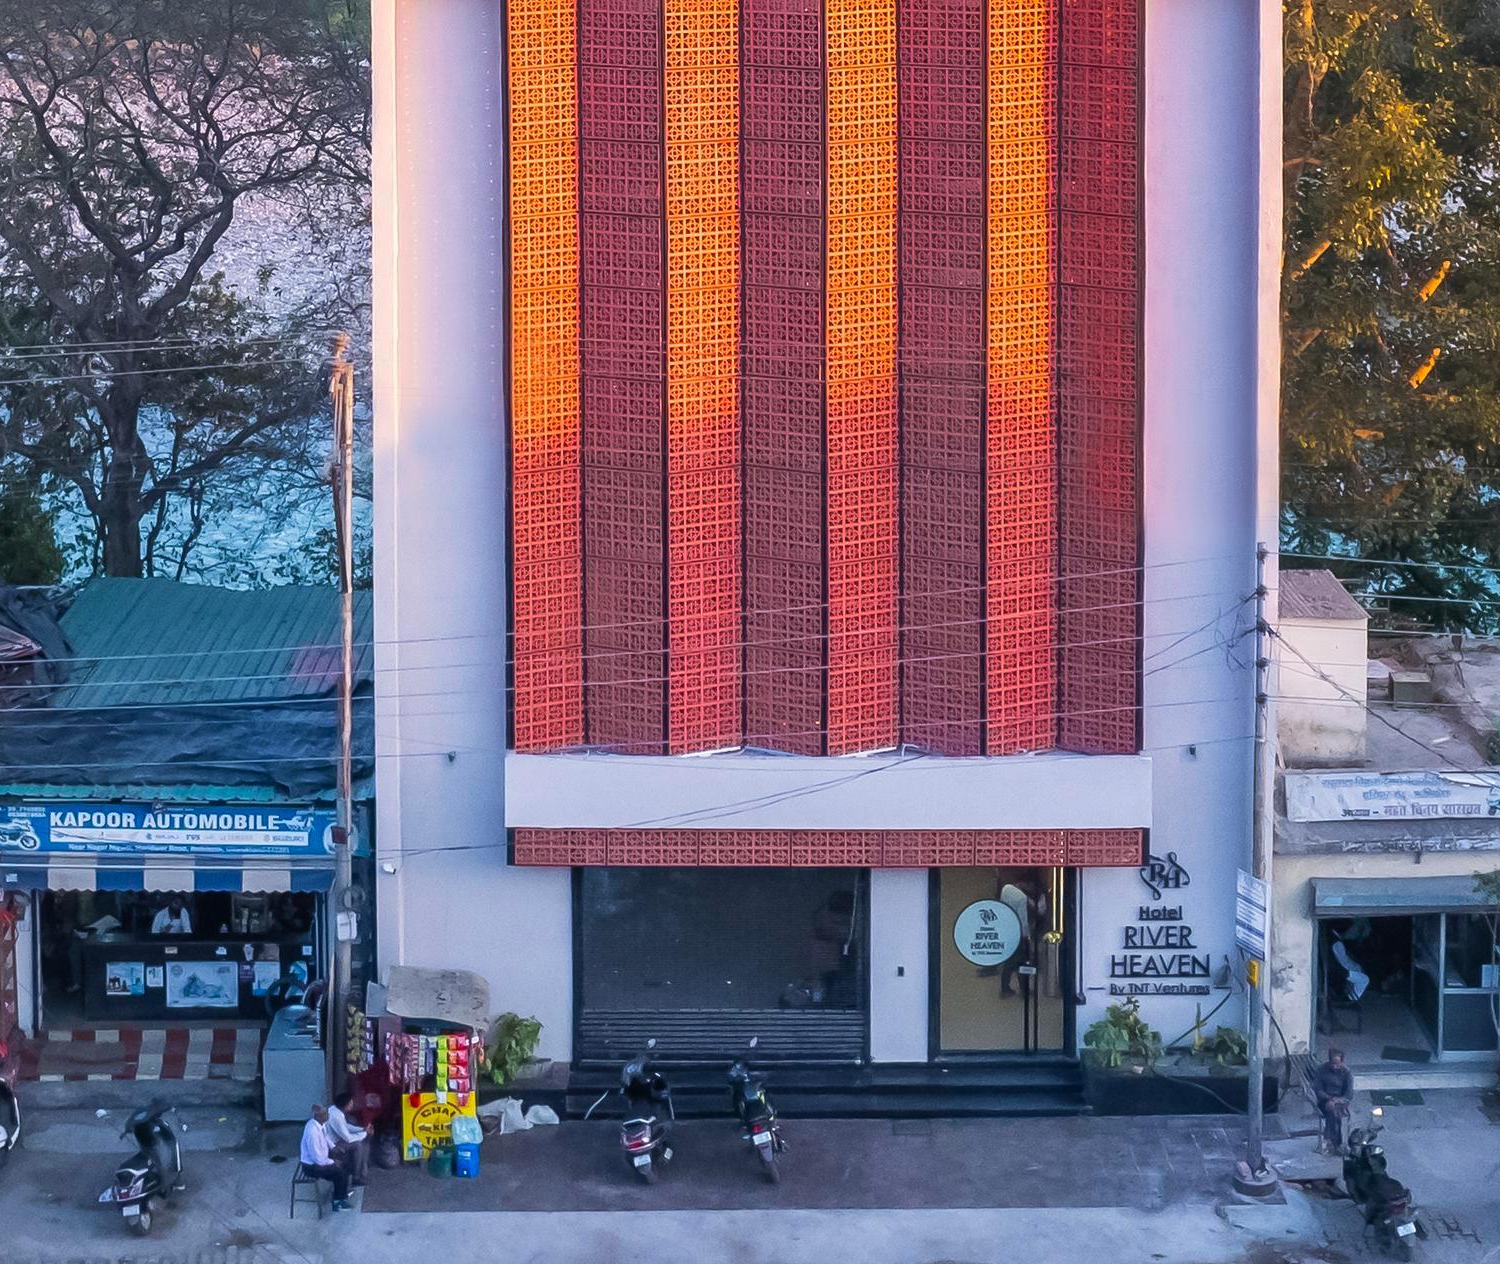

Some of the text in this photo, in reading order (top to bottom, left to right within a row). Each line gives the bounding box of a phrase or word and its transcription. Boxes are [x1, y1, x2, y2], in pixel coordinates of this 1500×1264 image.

[50, 811, 136, 828] KAPOOR
[142, 813, 280, 830] AUTOMOBILE
[1139, 905, 1183, 921] Hotel
[975, 932, 999, 940] RIVER
[1123, 926, 1195, 948] RIVER
[970, 942, 1005, 950] HEAVEN
[1110, 954, 1211, 977] HEAVEN
[1110, 983, 1211, 995] By TNT Ventures
